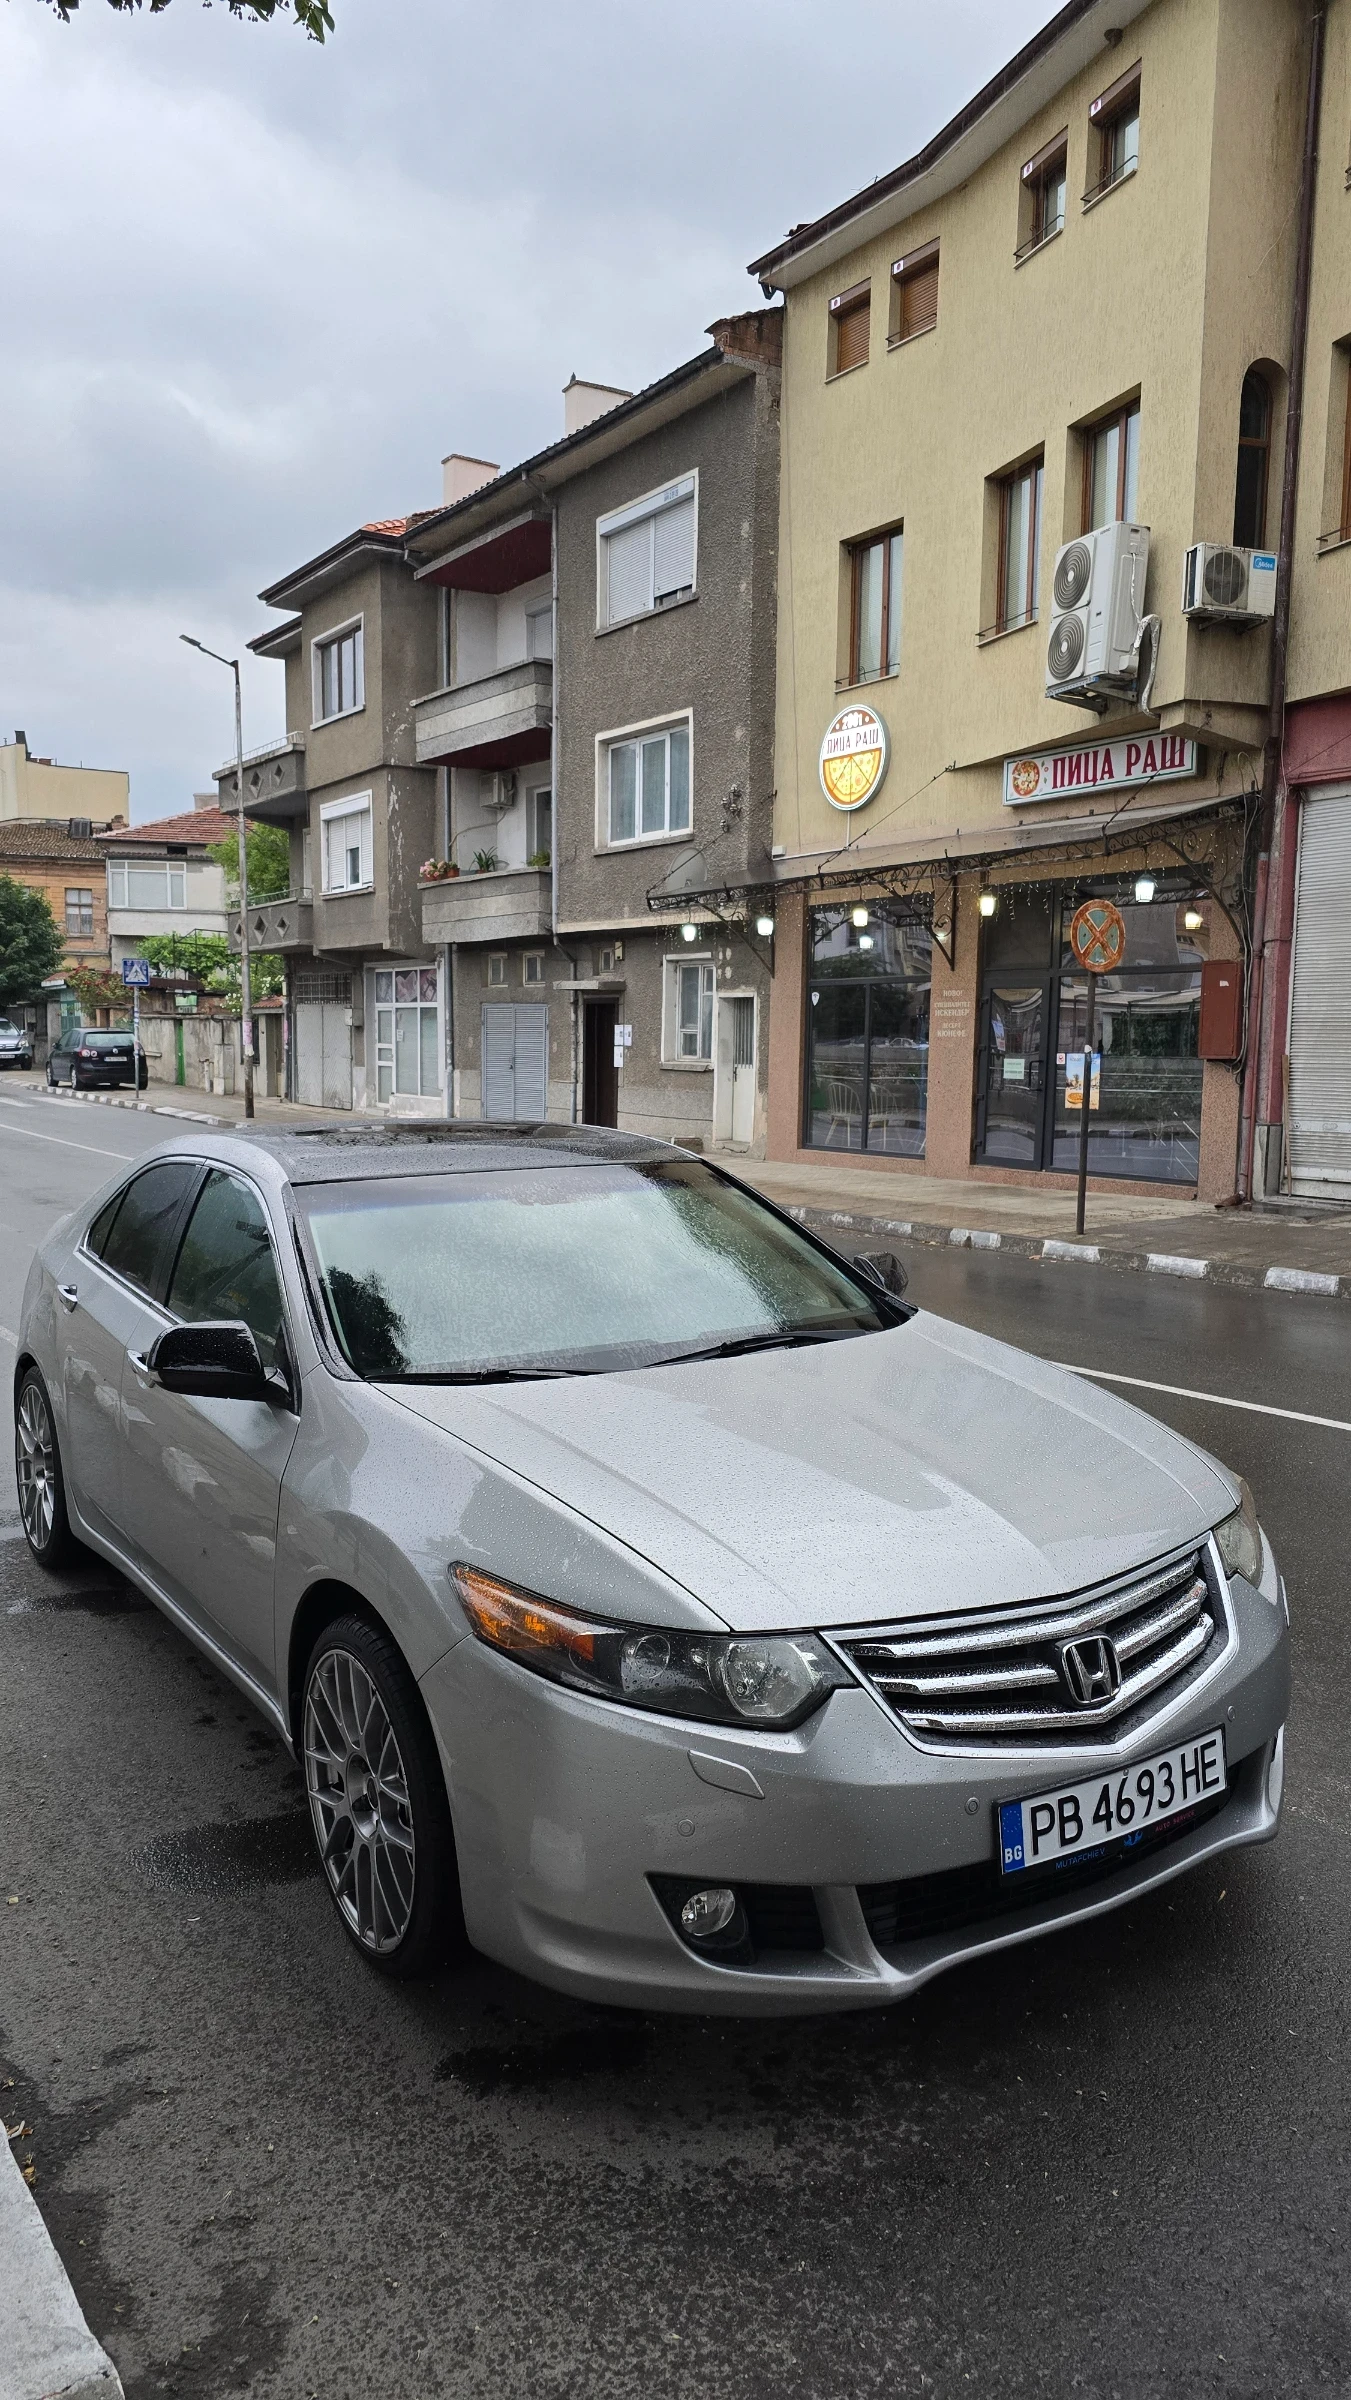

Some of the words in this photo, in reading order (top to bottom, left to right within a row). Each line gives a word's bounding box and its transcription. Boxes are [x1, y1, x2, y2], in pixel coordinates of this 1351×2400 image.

[827, 735, 851, 754] ПИЦА
[855, 728, 879, 747] РАШ
[1052, 747, 1115, 789] ПИЦА
[1125, 735, 1186, 776] РАШ
[1030, 1794, 1084, 1856] PB
[1092, 1761, 1175, 1833] 4693
[1180, 1738, 1220, 1801] HE
[1004, 1844, 1023, 1864] BG
[1055, 1847, 1107, 1870] MUTAFCHIEV
[1155, 1821, 1171, 1832] AUTO
[1172, 1810, 1196, 1825] SERVICE
